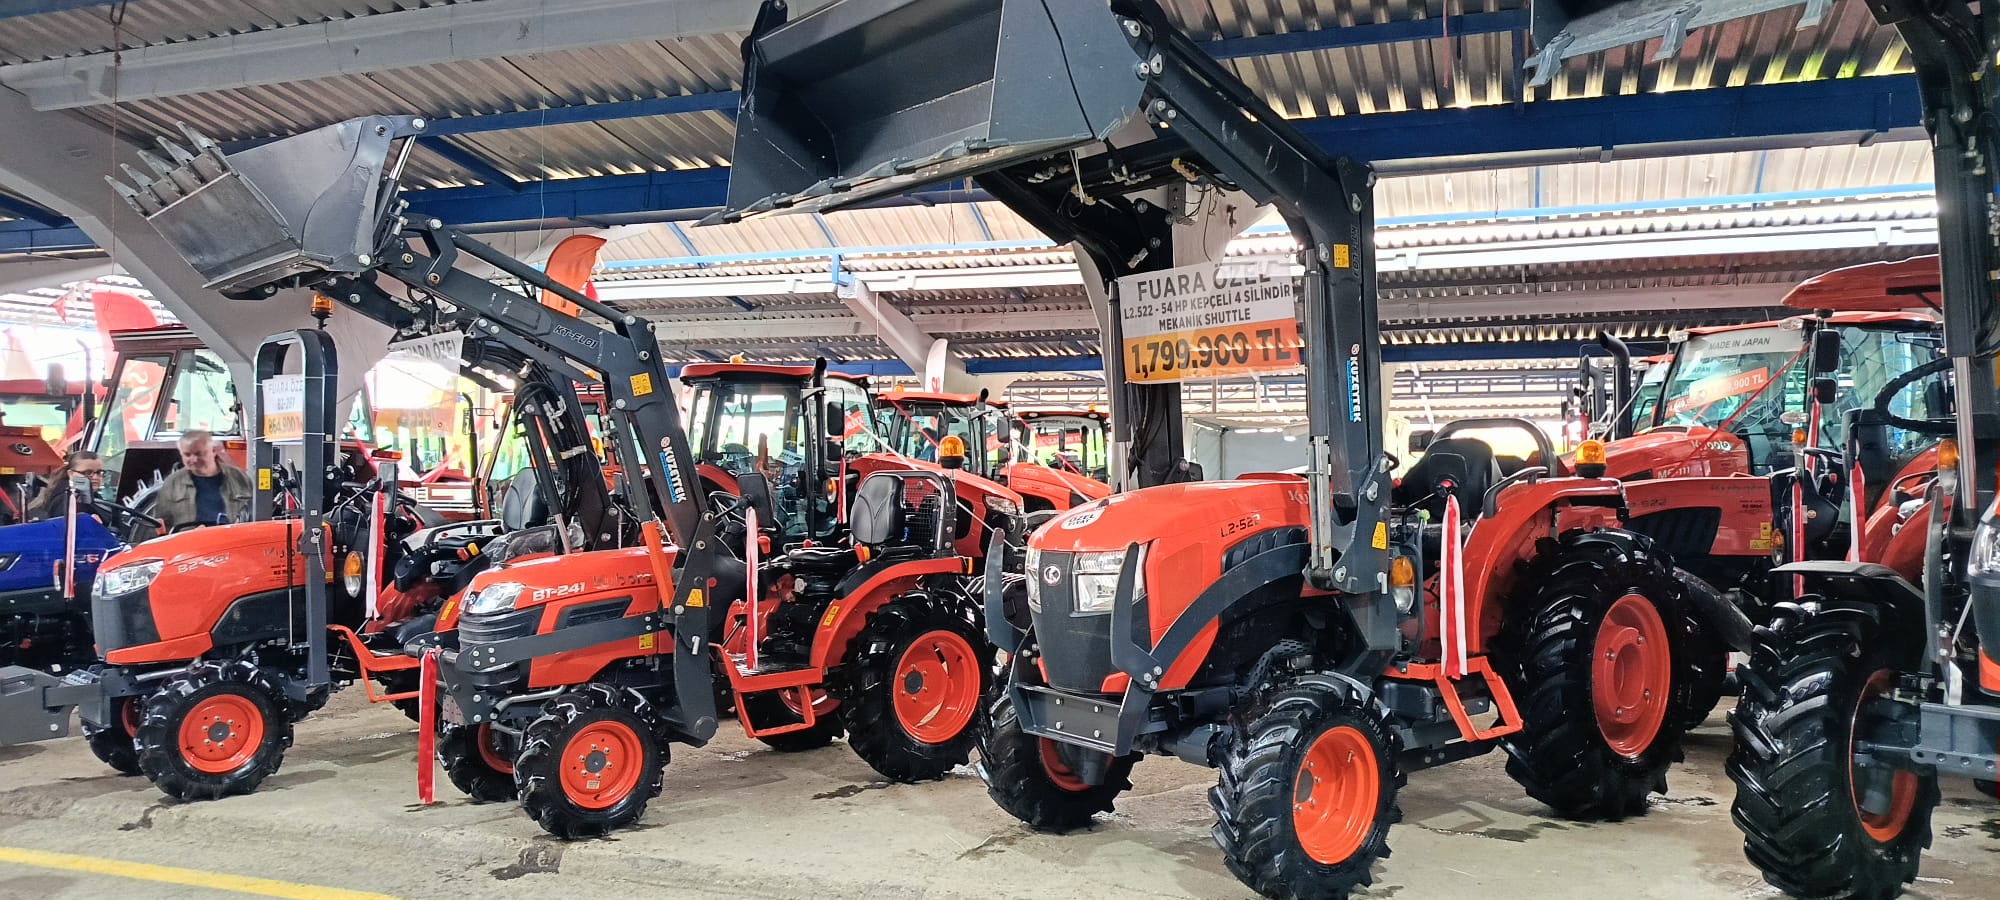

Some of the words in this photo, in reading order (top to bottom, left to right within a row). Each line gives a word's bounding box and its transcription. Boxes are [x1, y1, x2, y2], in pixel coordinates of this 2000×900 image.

[1137, 271, 1207, 302] FUARA
[1212, 263, 1272, 290] ÖZEL
[1124, 303, 1154, 320] L2.522
[1161, 302, 1174, 315] 54
[1175, 299, 1189, 313] HP
[1190, 291, 1232, 312] KEPÇELİ
[1234, 292, 1242, 304] 4
[1244, 284, 1292, 304] SİLİNDİR
[1158, 312, 1203, 332] MEKANİK
[1205, 308, 1252, 326] SHUTTLE
[1256, 327, 1292, 362] TL
[1709, 340, 1731, 350] MADE
[1731, 340, 1741, 348] IN
[1741, 337, 1771, 348] JAPAN
[290, 378, 303, 393] ÖZE
[1350, 356, 1362, 423] KUZEYTEK
[1752, 374, 1764, 384] TL
[662, 446, 687, 504] KUZEYTEK
[532, 582, 586, 602] BT-241
